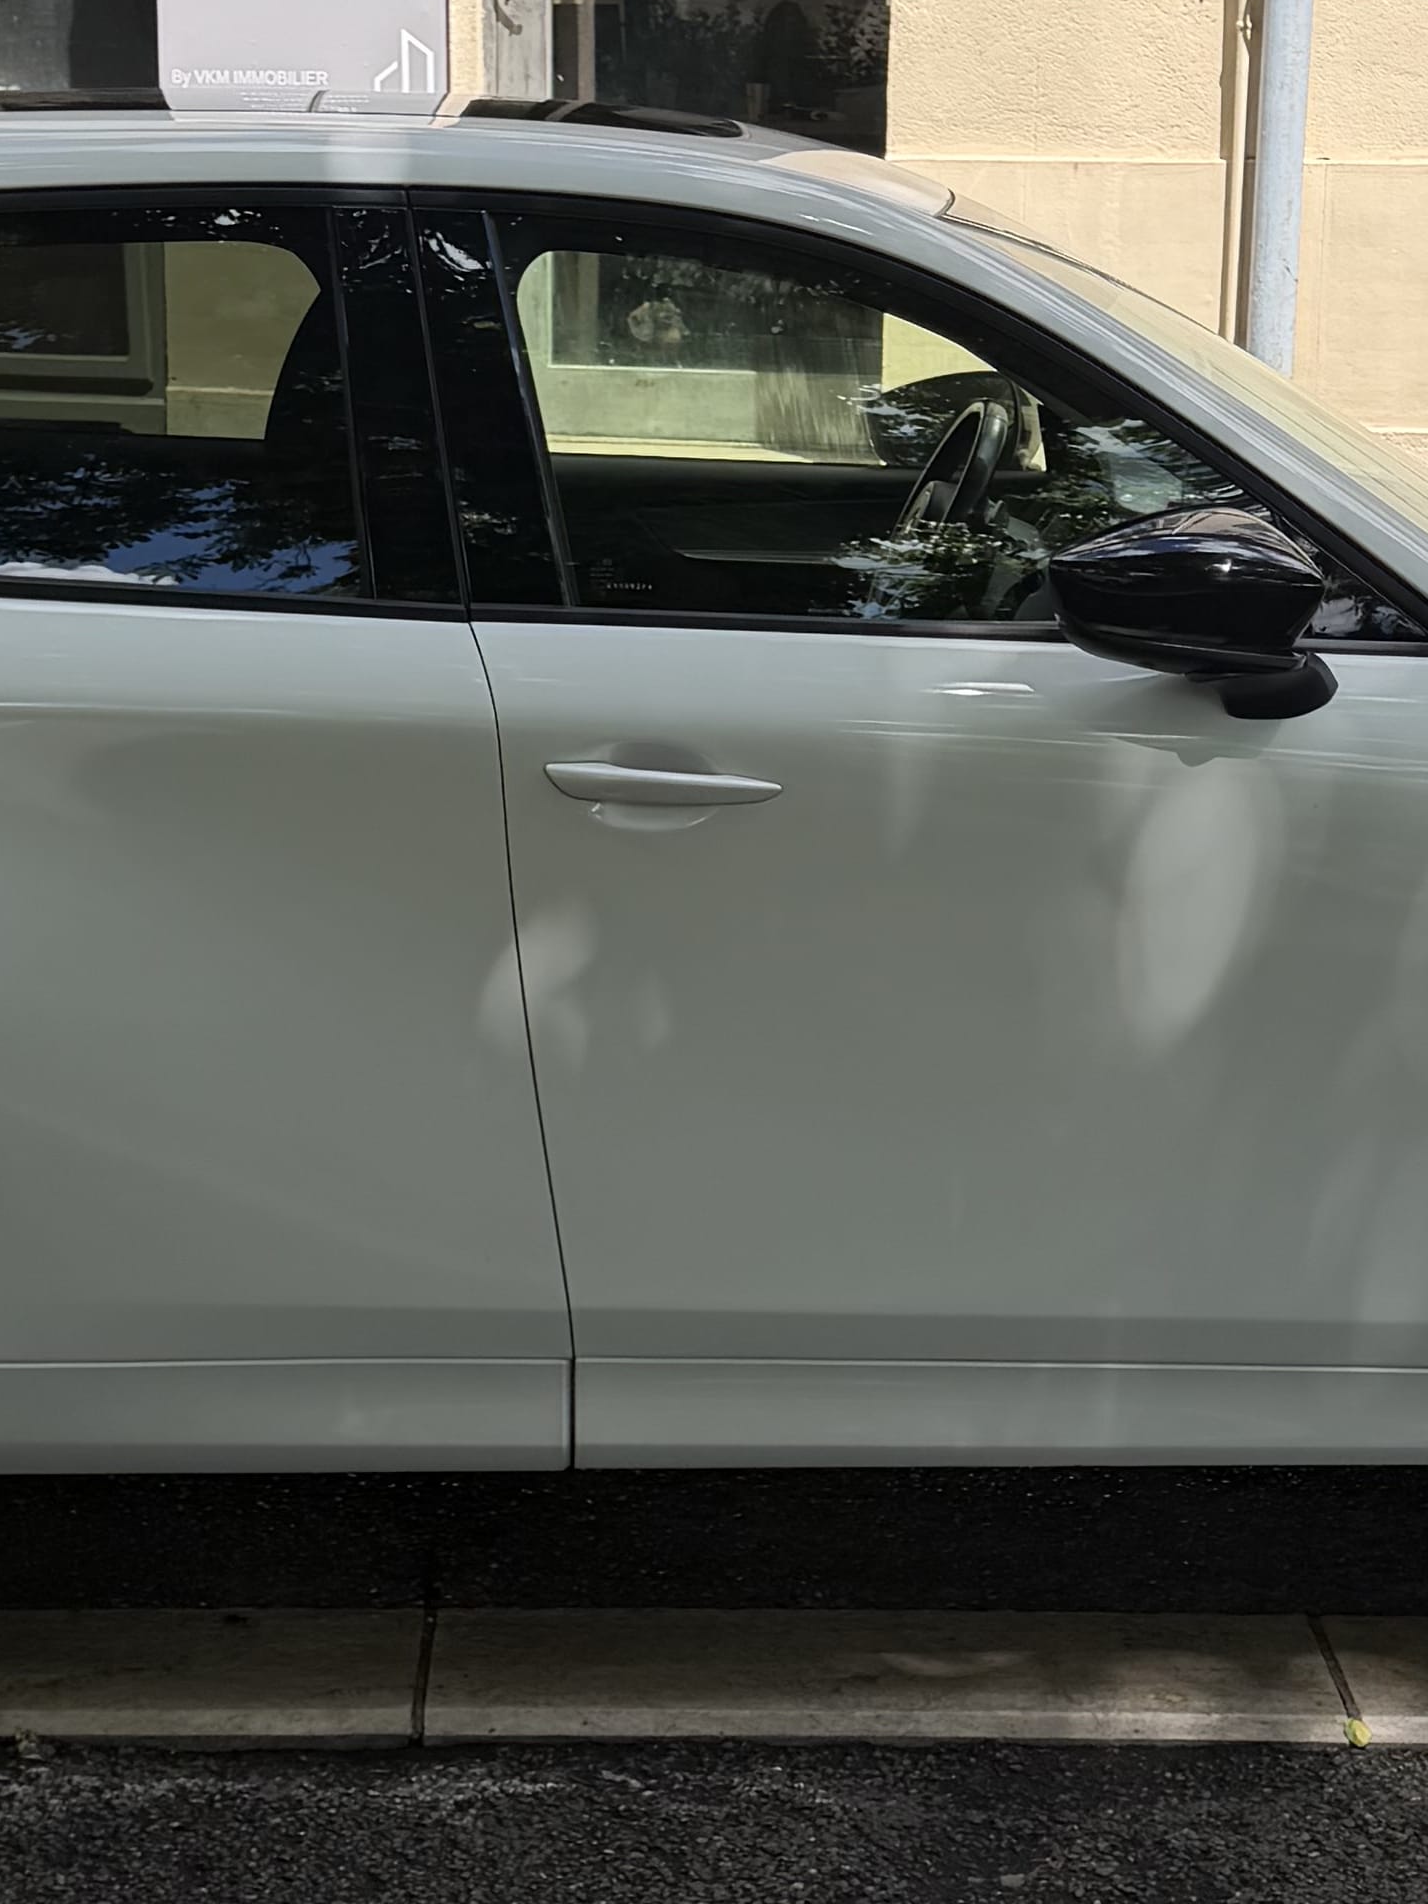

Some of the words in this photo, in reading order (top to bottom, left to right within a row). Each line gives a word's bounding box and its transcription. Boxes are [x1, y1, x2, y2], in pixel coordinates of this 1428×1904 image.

[172, 69, 192, 88] By
[194, 70, 230, 85] VKM
[233, 70, 329, 86] IMMOBILIER
